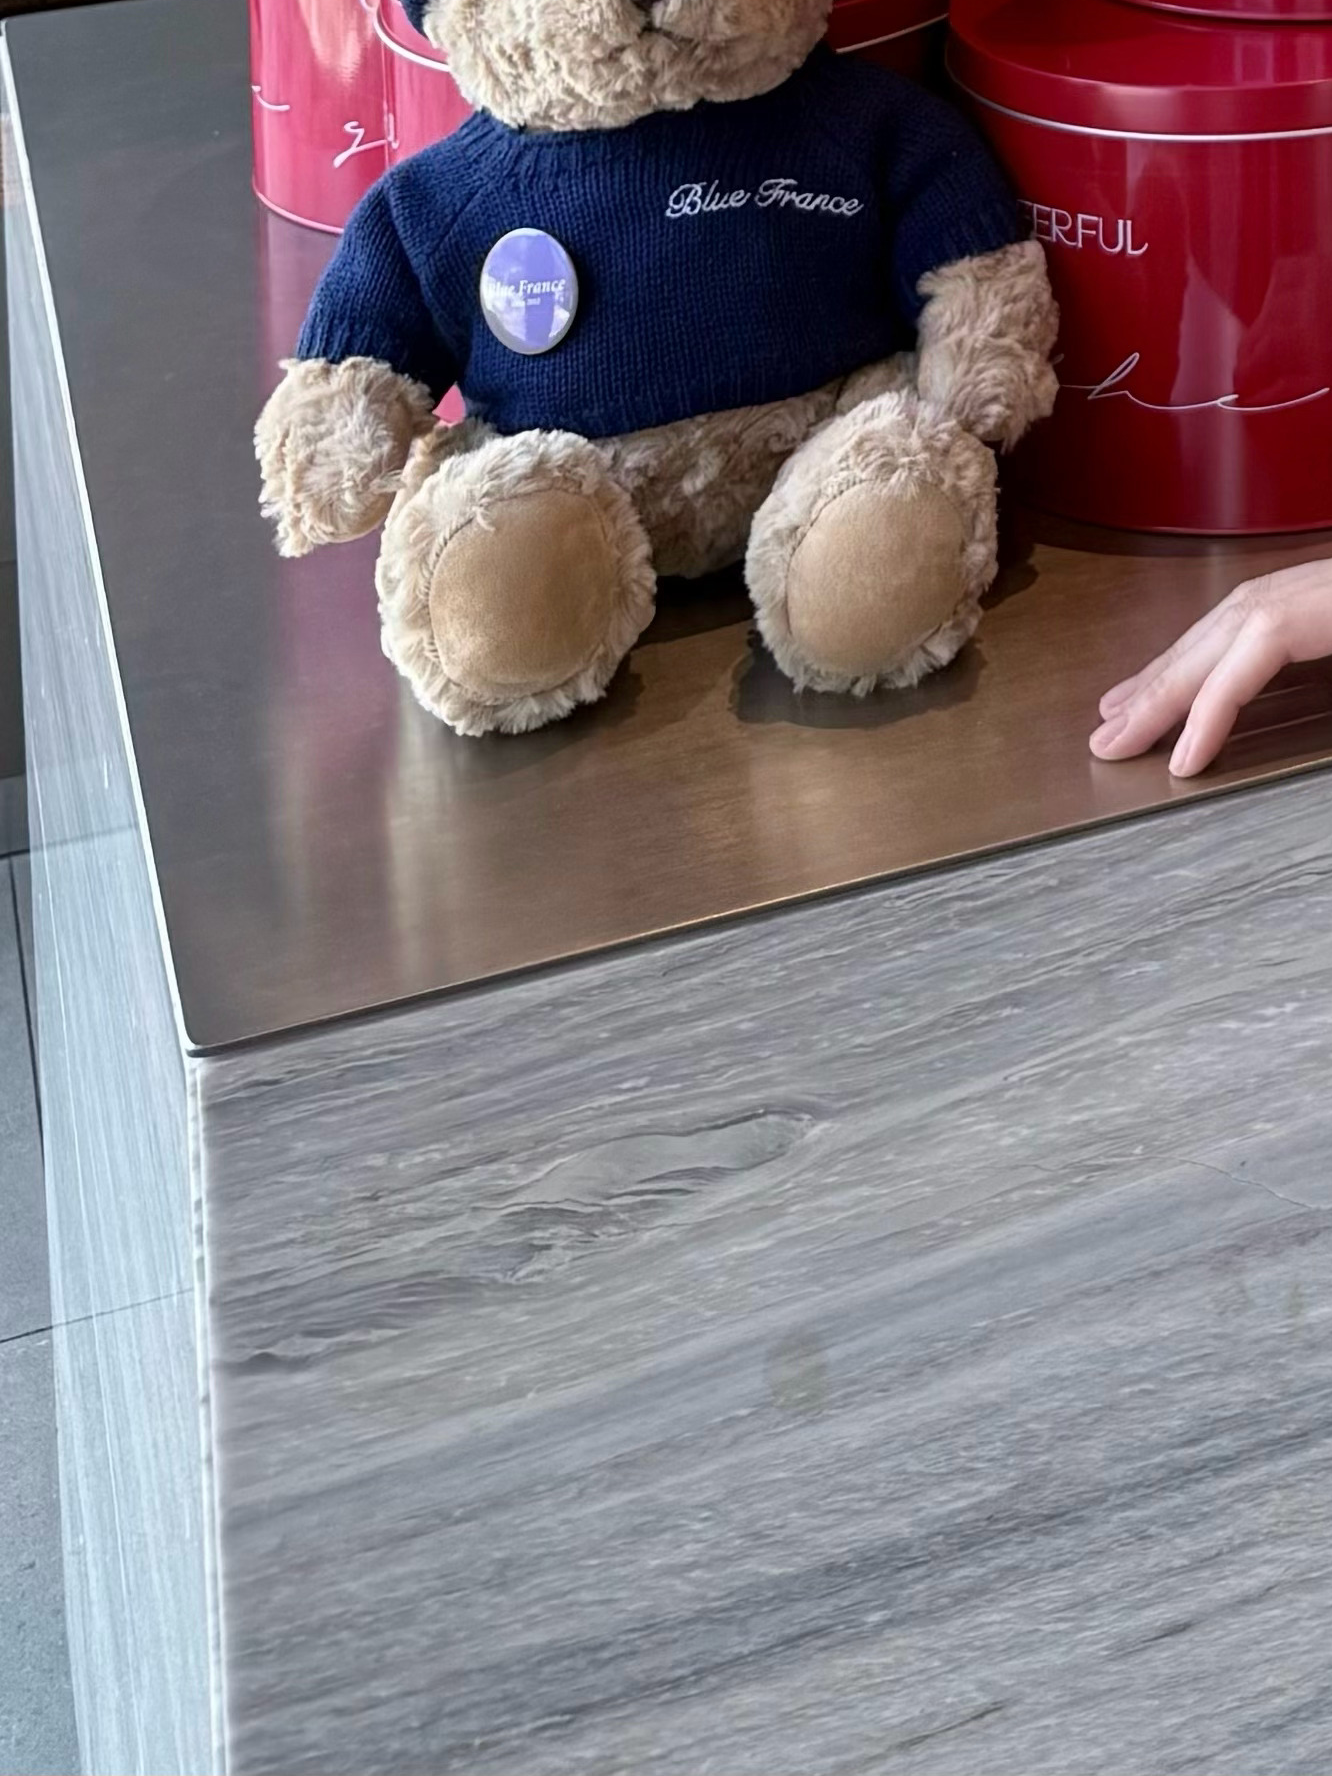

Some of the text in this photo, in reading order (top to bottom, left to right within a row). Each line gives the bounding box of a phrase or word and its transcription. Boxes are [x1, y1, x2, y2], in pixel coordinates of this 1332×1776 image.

[665, 177, 864, 218] Blue France
[517, 278, 566, 298] France
